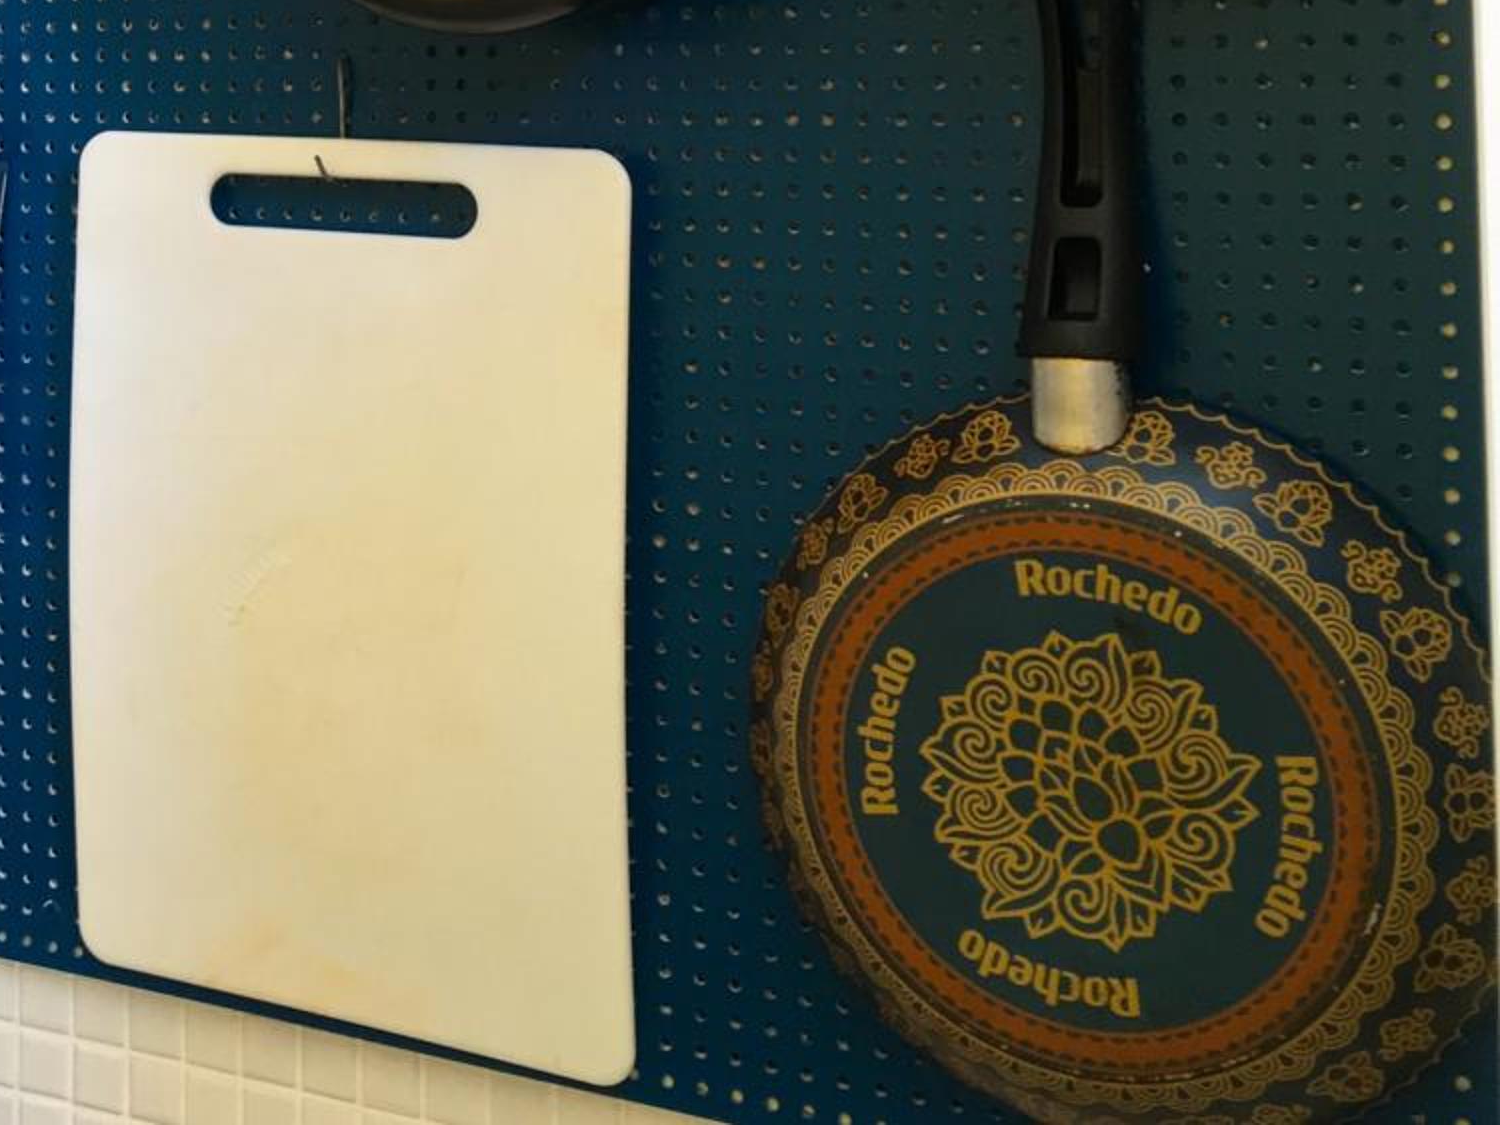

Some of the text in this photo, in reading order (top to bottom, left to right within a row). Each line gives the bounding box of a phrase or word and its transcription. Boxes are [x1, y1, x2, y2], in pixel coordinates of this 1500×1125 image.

[1014, 558, 1202, 636] Rochedo
[859, 646, 916, 815] Rochedo
[1255, 755, 1321, 939] Rochedo
[958, 930, 1140, 1019] Rochedo
